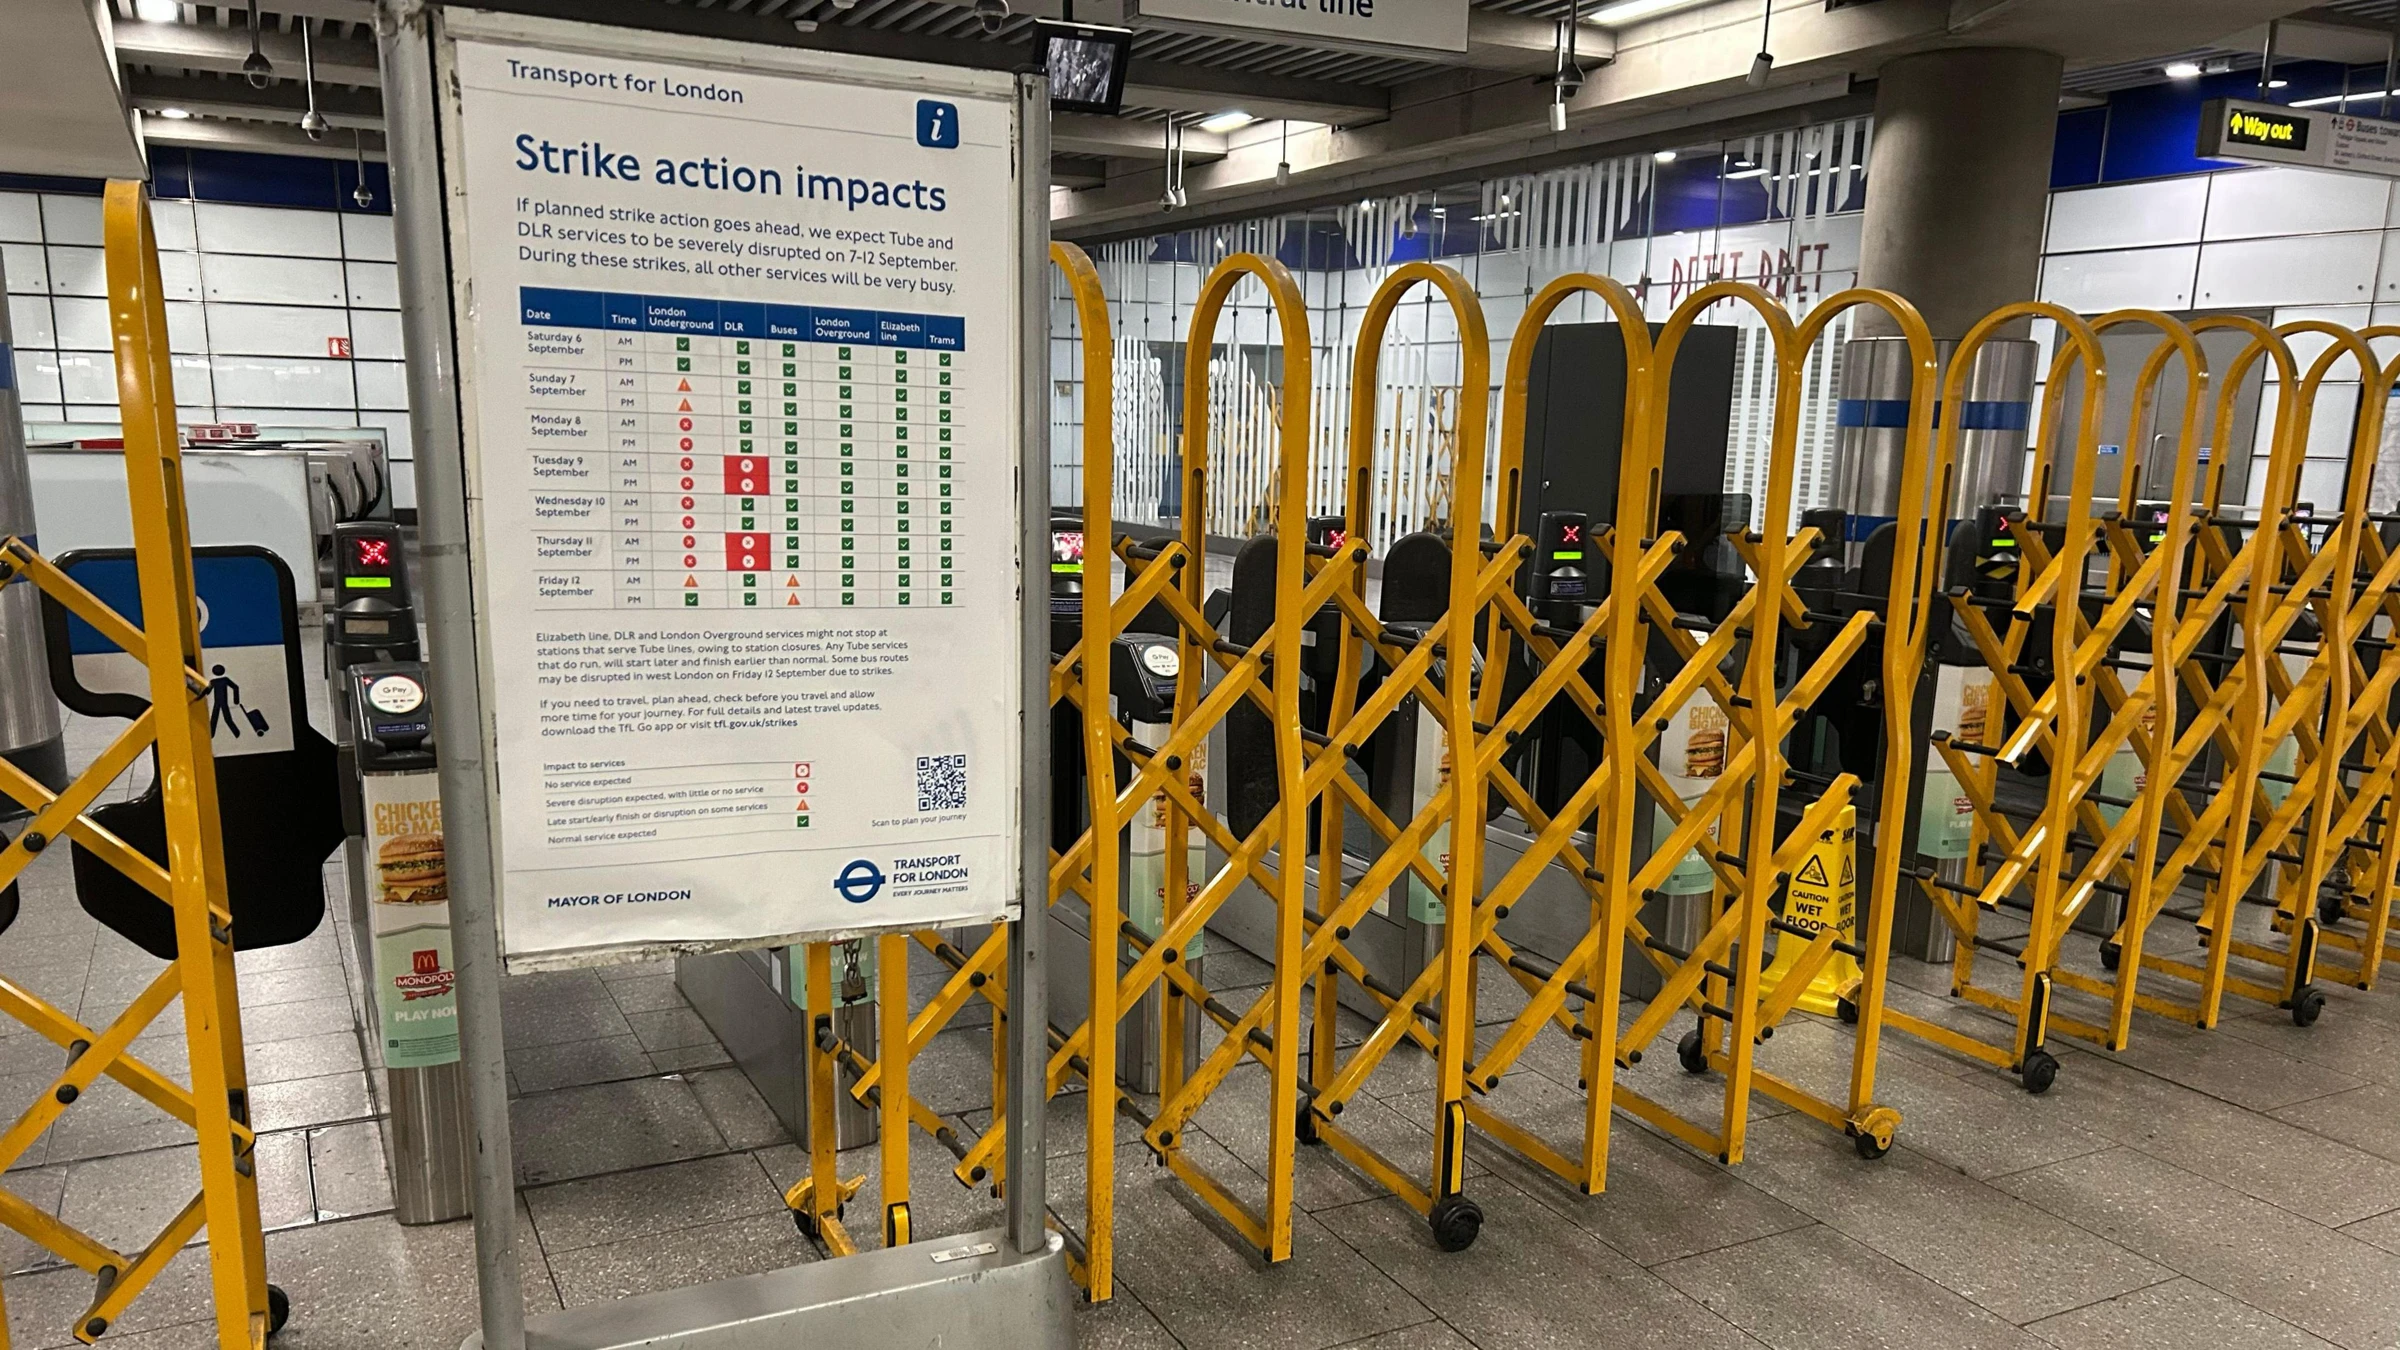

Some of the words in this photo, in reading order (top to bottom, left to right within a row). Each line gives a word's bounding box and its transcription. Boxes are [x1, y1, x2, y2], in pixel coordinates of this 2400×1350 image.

[506, 59, 618, 89] Transport
[624, 73, 656, 93] for
[664, 77, 743, 103] London
[2244, 116, 2271, 141] Way
[2270, 123, 2293, 140] out
[516, 134, 639, 181] Strike
[655, 156, 781, 195] action
[797, 165, 945, 211] impacts
[517, 197, 529, 212] If
[534, 199, 604, 219] planned
[609, 208, 655, 223] strike
[660, 213, 709, 228] action
[713, 218, 750, 233] goes
[755, 219, 804, 237] ahead,
[808, 227, 831, 239] we
[835, 229, 885, 244] expect
[889, 231, 923, 247] Tube
[927, 237, 953, 250] and
[518, 221, 553, 239] DLR
[558, 228, 626, 244] services
[630, 232, 648, 246] to
[654, 232, 673, 248] be
[678, 238, 743, 257] severely
[748, 241, 820, 261] disrupted
[825, 251, 844, 262] on
[849, 249, 874, 264] 7-12
[879, 252, 957, 271] September.
[519, 245, 576, 268] During
[580, 251, 627, 268] these
[632, 256, 690, 273] strikes,
[694, 260, 713, 275] all
[718, 262, 761, 277] other
[766, 268, 827, 283] services
[831, 271, 859, 285] will
[863, 272, 881, 287] be
[885, 277, 916, 293] very
[920, 277, 955, 296] busy.
[526, 308, 550, 319] Date
[648, 305, 686, 319] London
[611, 314, 636, 325] Time
[649, 316, 714, 330] Underground
[815, 316, 850, 329] London
[724, 321, 743, 331] DLR
[771, 324, 797, 335] Buses
[881, 320, 920, 333] Elizabeth
[527, 330, 572, 344] Saturday
[575, 333, 582, 343] 6
[815, 327, 870, 339] Overground
[881, 331, 897, 341] line
[617, 337, 632, 345] AM
[929, 334, 955, 345] Trams
[528, 343, 584, 355] September
[619, 357, 632, 365] PM
[529, 372, 567, 386] Sunday
[570, 374, 575, 383] 7
[619, 378, 633, 386] AM
[529, 384, 586, 396] September
[620, 398, 634, 406] PM
[531, 414, 572, 427] Monday
[575, 416, 581, 425] 8
[620, 418, 635, 426] AM
[531, 426, 588, 437] September
[622, 438, 635, 446] PM
[532, 455, 574, 467] Tuesday
[577, 456, 583, 465] 9
[533, 466, 589, 477] September
[623, 478, 637, 486] PM
[534, 496, 593, 507] Wednesday
[595, 497, 605, 505] 10
[623, 498, 638, 506] AM
[535, 507, 590, 518] September
[624, 518, 638, 526] PM
[536, 536, 583, 547] Thursday
[586, 537, 592, 545] 11
[537, 546, 592, 558] September
[538, 576, 569, 586] Friday
[571, 576, 580, 584] 12
[539, 585, 593, 597] September
[536, 632, 586, 642] Elizabeth
[588, 632, 611, 641] line,
[614, 631, 635, 640] DLR
[638, 631, 657, 640] and
[660, 630, 700, 640] London
[703, 630, 763, 641] Overground
[765, 630, 804, 638] services
[806, 629, 834, 639] might
[836, 629, 853, 637] not
[855, 629, 876, 638] stop
[878, 629, 887, 637] at
[541, 725, 595, 736] download
[598, 725, 616, 733] the
[618, 723, 634, 732] TfL
[637, 722, 652, 731] Go
[654, 723, 673, 732] app
[676, 722, 687, 730] or
[689, 721, 711, 729] visit
[713, 718, 798, 730] tfl.gov.uk/strikes
[543, 762, 575, 771] Impact
[590, 760, 625, 768] services
[560, 780, 591, 788] service
[592, 776, 631, 787] expected
[871, 819, 889, 827] Scan
[901, 817, 918, 826] plan
[920, 816, 937, 825] your
[938, 814, 967, 823] journey
[376, 823, 409, 836] BIG
[547, 834, 582, 844] Normal
[584, 833, 616, 841] service
[617, 828, 657, 839] expected
[893, 854, 961, 869] TRANSPORT
[893, 872, 916, 883] FOR
[919, 867, 968, 881] LONDON
[548, 895, 599, 908] MAYOR
[603, 893, 623, 904] OF
[627, 889, 690, 902] LONDON
[1792, 890, 1829, 903] CAUTION
[1795, 901, 1822, 916] WET
[397, 973, 455, 986] MONOPOLY
[395, 1009, 430, 1022] PLAY
